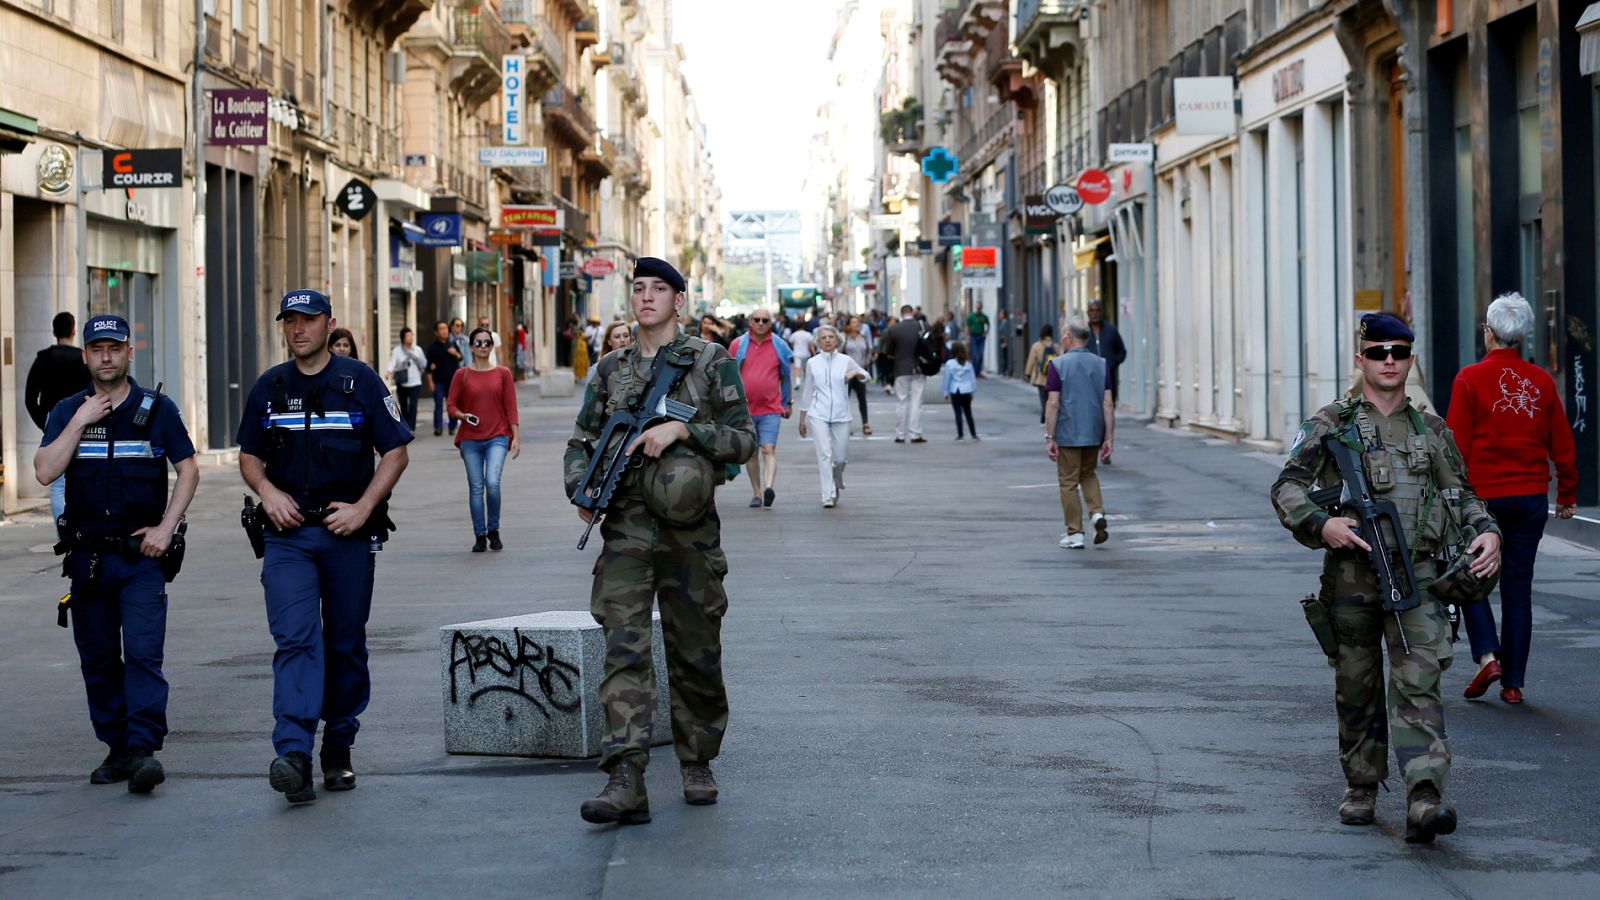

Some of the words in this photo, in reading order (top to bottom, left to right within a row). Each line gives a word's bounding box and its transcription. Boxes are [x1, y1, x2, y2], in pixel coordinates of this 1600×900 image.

[506, 59, 519, 141] HOTEL
[214, 97, 225, 114] La
[227, 96, 265, 117] Boutique
[215, 121, 227, 138] du
[228, 121, 265, 138] Coiffeur
[483, 149, 497, 158] DU
[499, 149, 540, 158] DAUPHIN
[113, 173, 173, 185] COURIR
[287, 294, 311, 303] POLICE
[93, 320, 117, 328] POLICE
